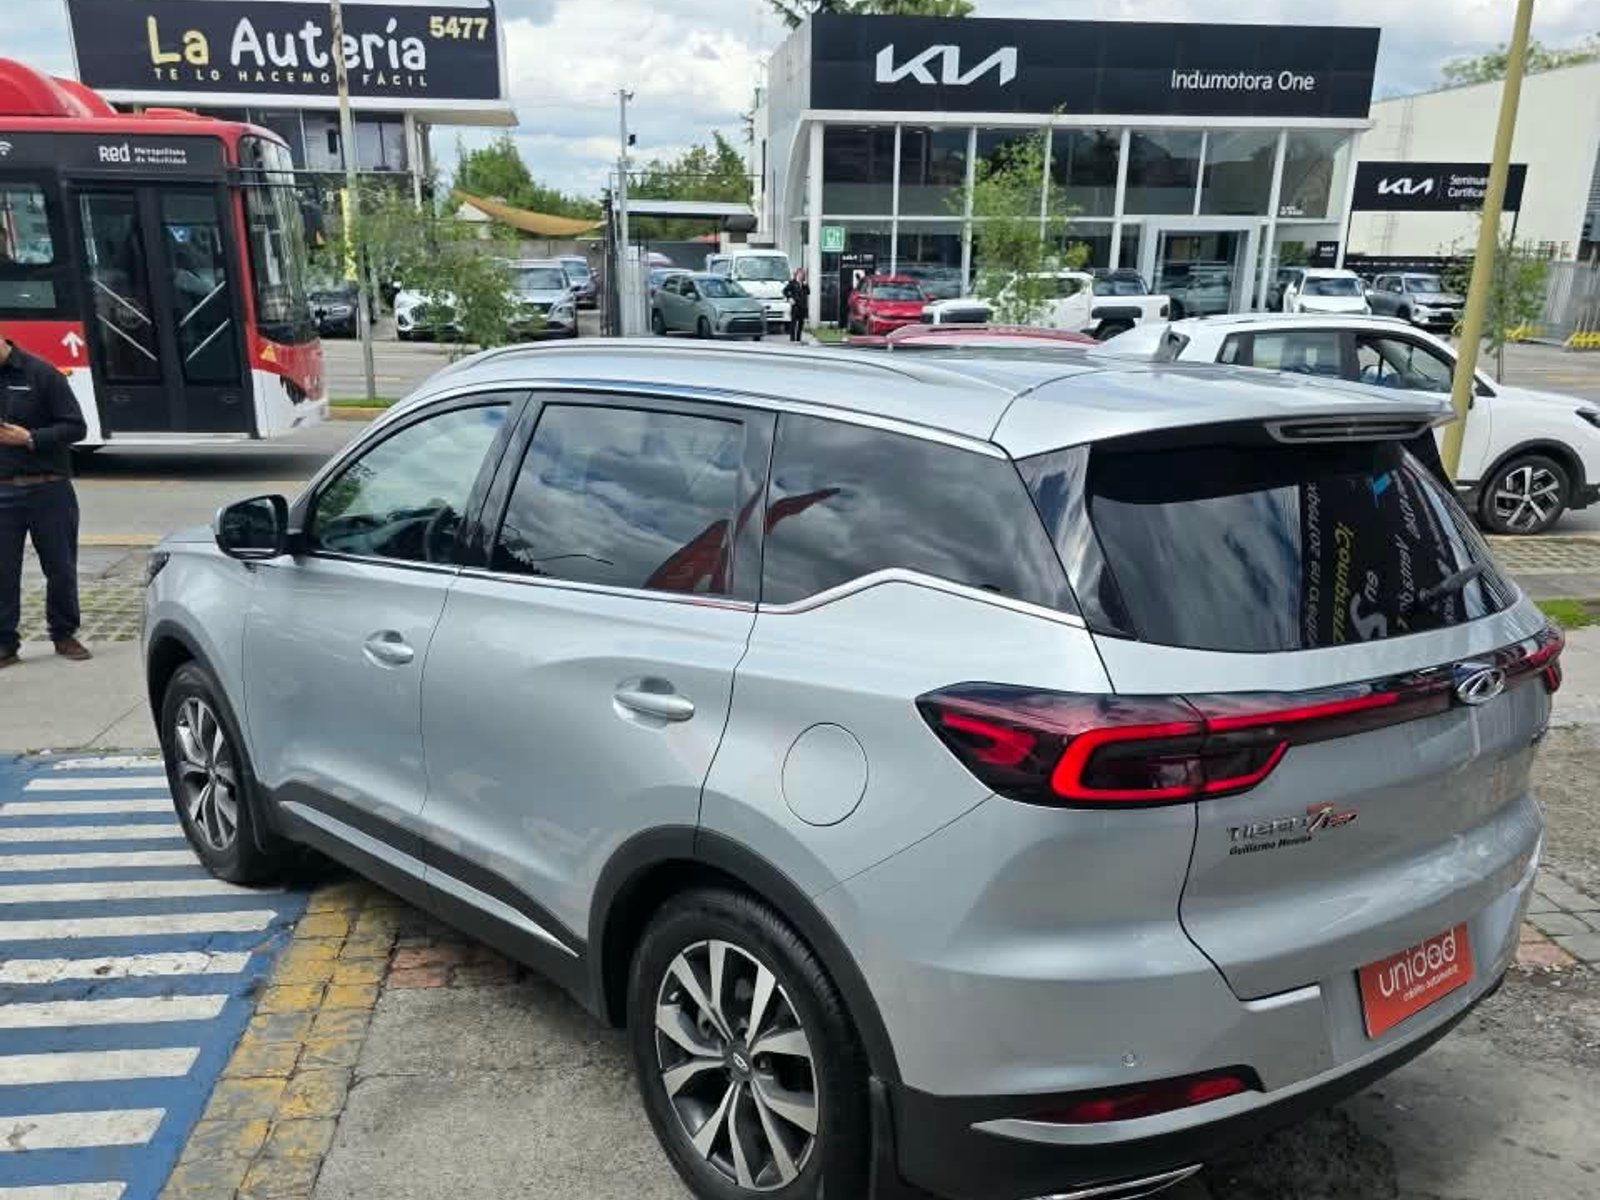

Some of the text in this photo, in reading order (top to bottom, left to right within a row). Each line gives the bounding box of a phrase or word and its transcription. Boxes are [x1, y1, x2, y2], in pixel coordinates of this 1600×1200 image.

[430, 15, 489, 40] 5477
[147, 15, 426, 71] La Autería
[154, 67, 179, 81] TE
[196, 69, 220, 81] LO
[238, 70, 331, 84] HACEMO
[876, 44, 1018, 86] KIA
[1171, 69, 1315, 91] Indumotora One
[98, 142, 131, 162] Red
[1379, 927, 1456, 997] unidad
